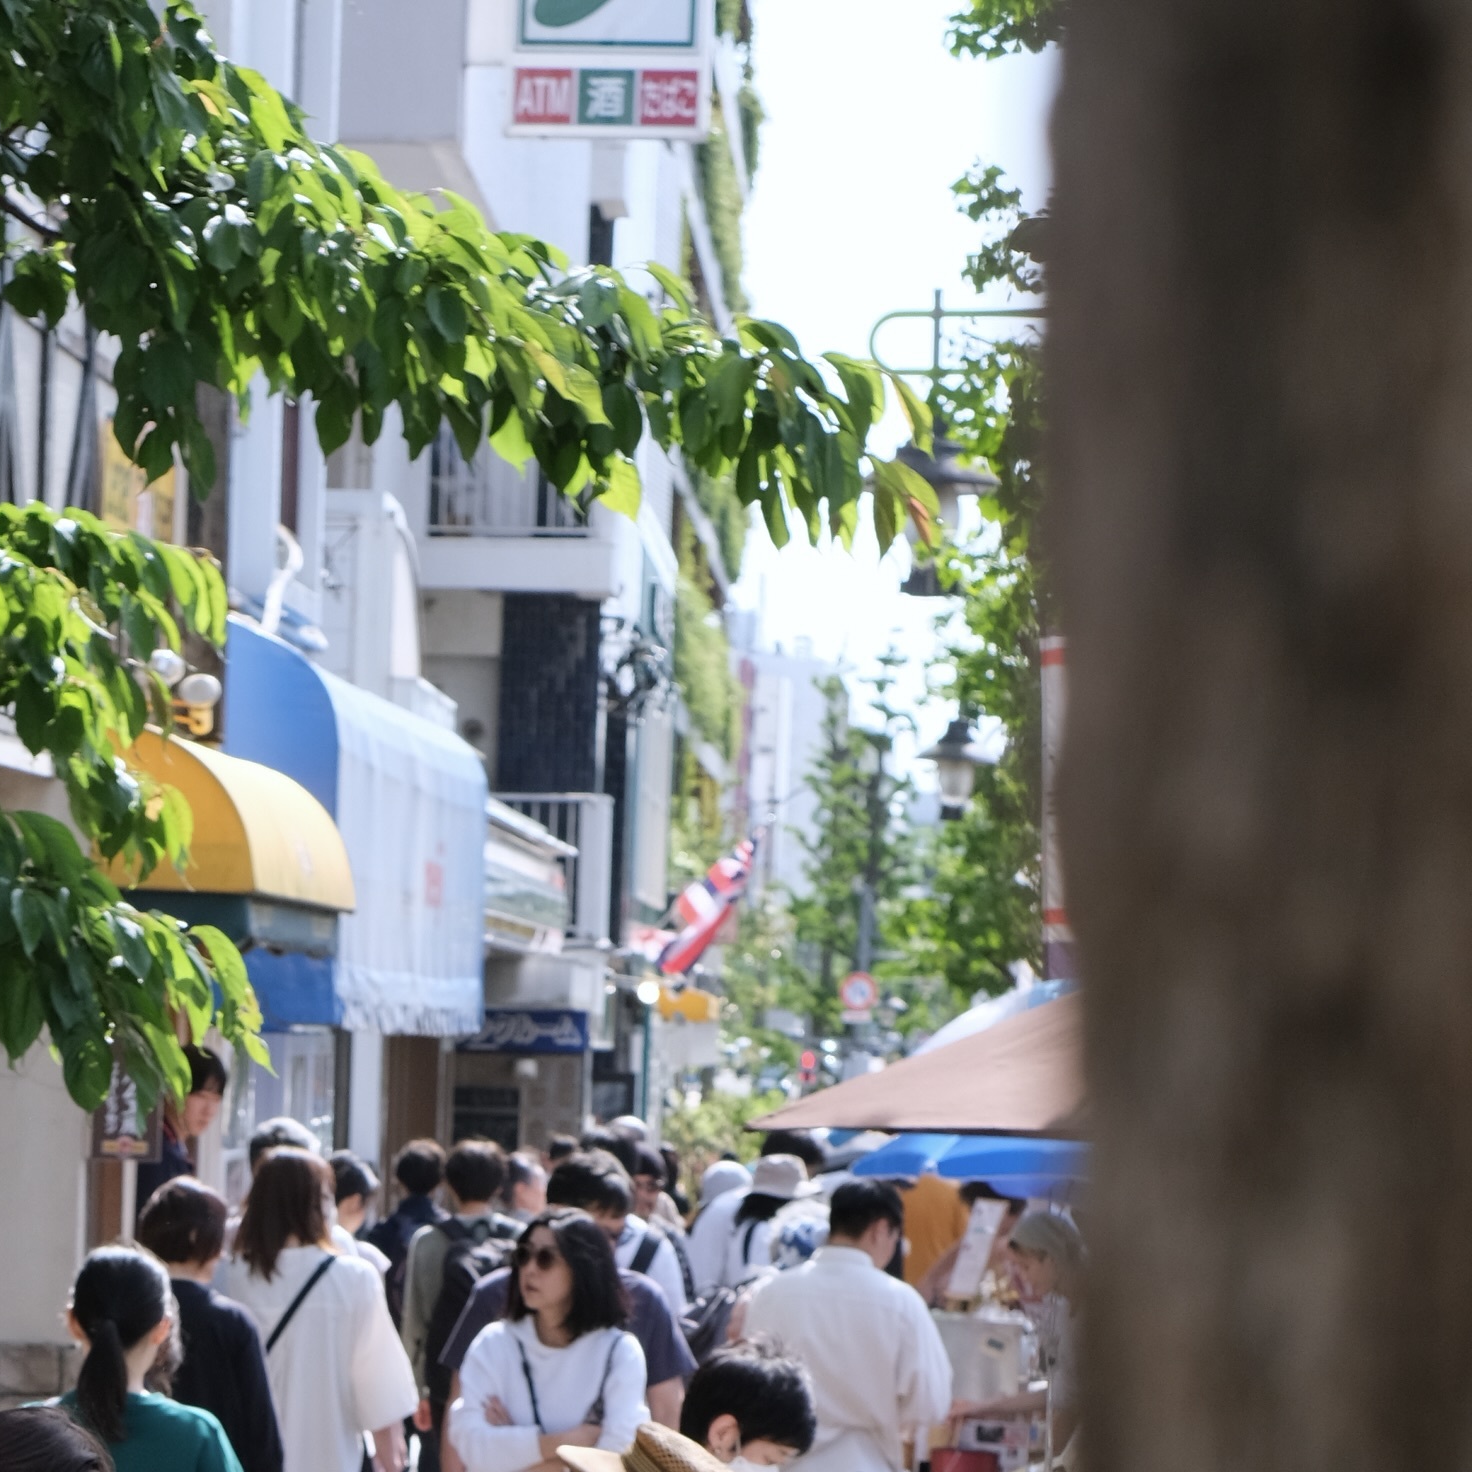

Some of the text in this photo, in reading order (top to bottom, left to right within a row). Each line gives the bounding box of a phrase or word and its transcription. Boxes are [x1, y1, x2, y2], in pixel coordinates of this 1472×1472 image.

[517, 76, 570, 115] ATM
[586, 77, 627, 118] 酒
[642, 78, 696, 117] たばこ
